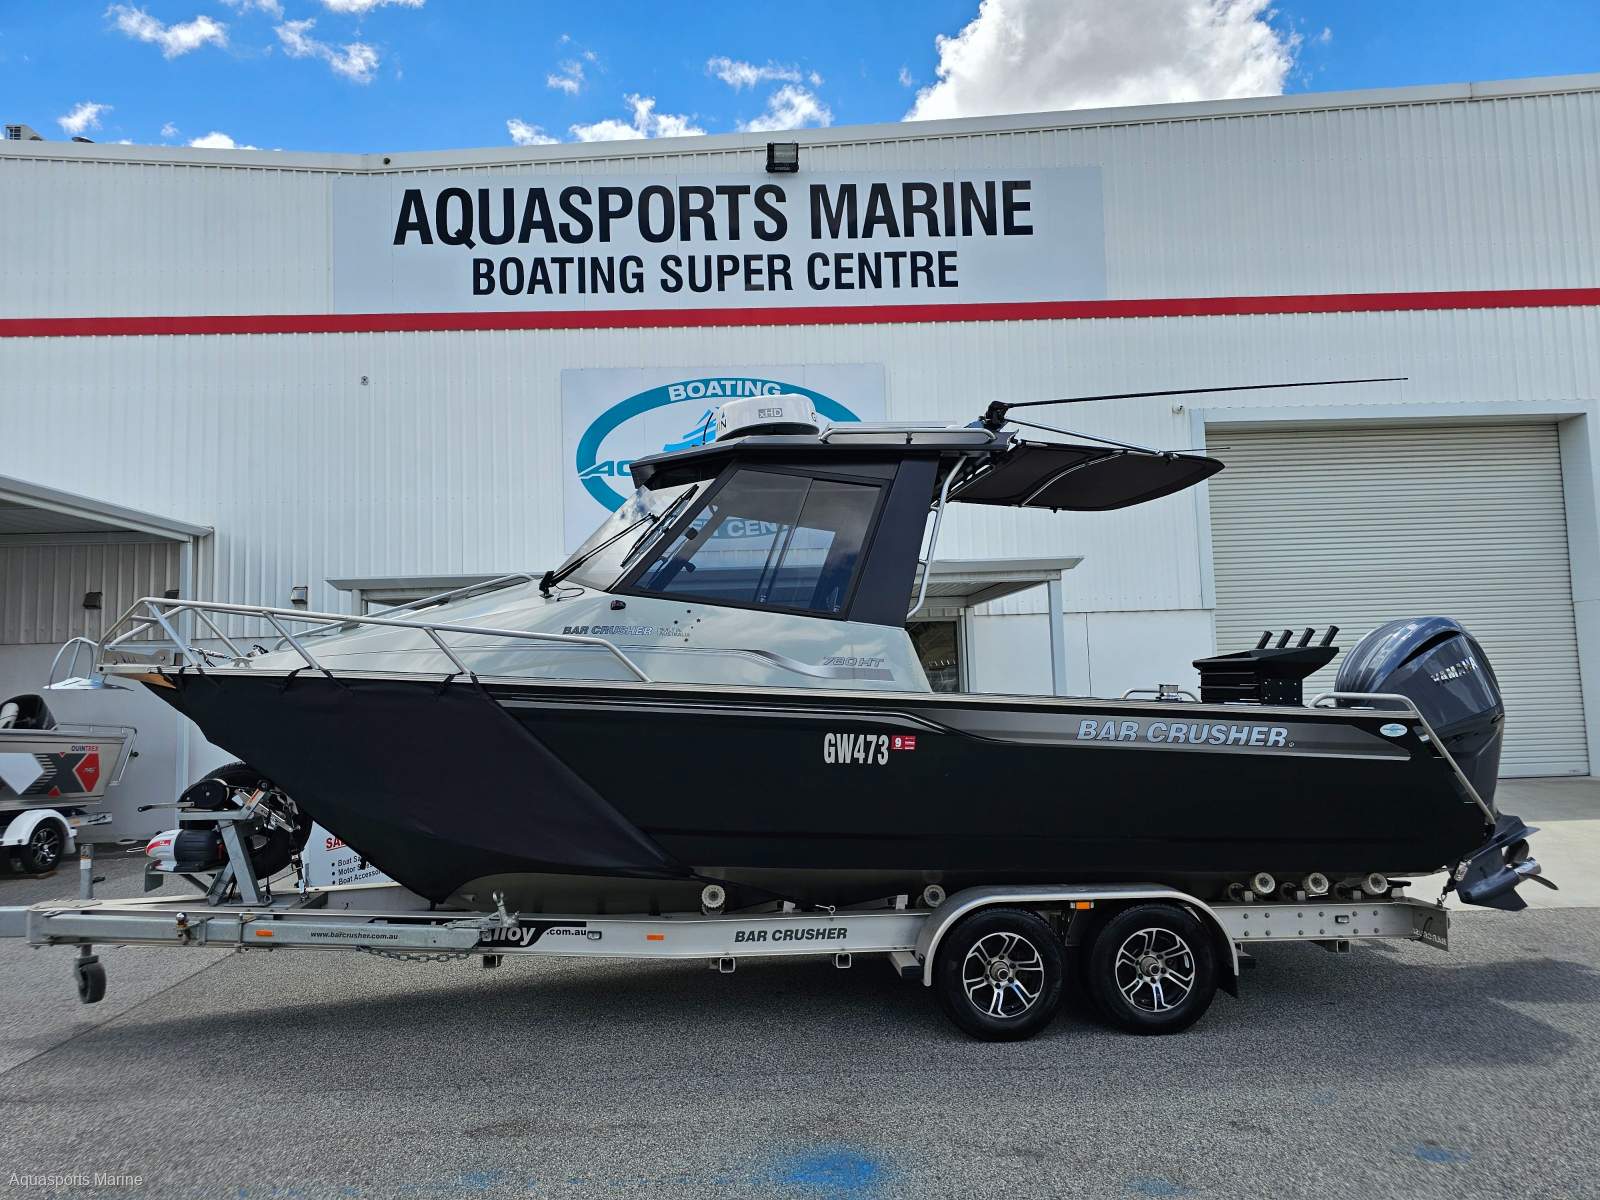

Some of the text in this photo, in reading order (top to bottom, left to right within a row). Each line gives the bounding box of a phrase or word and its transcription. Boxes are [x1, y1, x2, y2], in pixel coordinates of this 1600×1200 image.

[393, 180, 1034, 249] AQUASPORTS MARINE
[472, 251, 959, 295] BOATING SUPER CENTRE
[668, 380, 782, 402] BOATING
[562, 626, 590, 635] BAR
[591, 625, 653, 636] CRUSHER
[1430, 656, 1478, 683] YAMAHA
[1076, 719, 1288, 747] BAR CRUSHER
[823, 732, 889, 766] GW473
[337, 857, 352, 867] Boat
[338, 866, 356, 876] Motor
[338, 876, 353, 885] Boat
[310, 930, 399, 940] www.barcrusher.com.au
[734, 927, 848, 943] BAR CRUSHER
